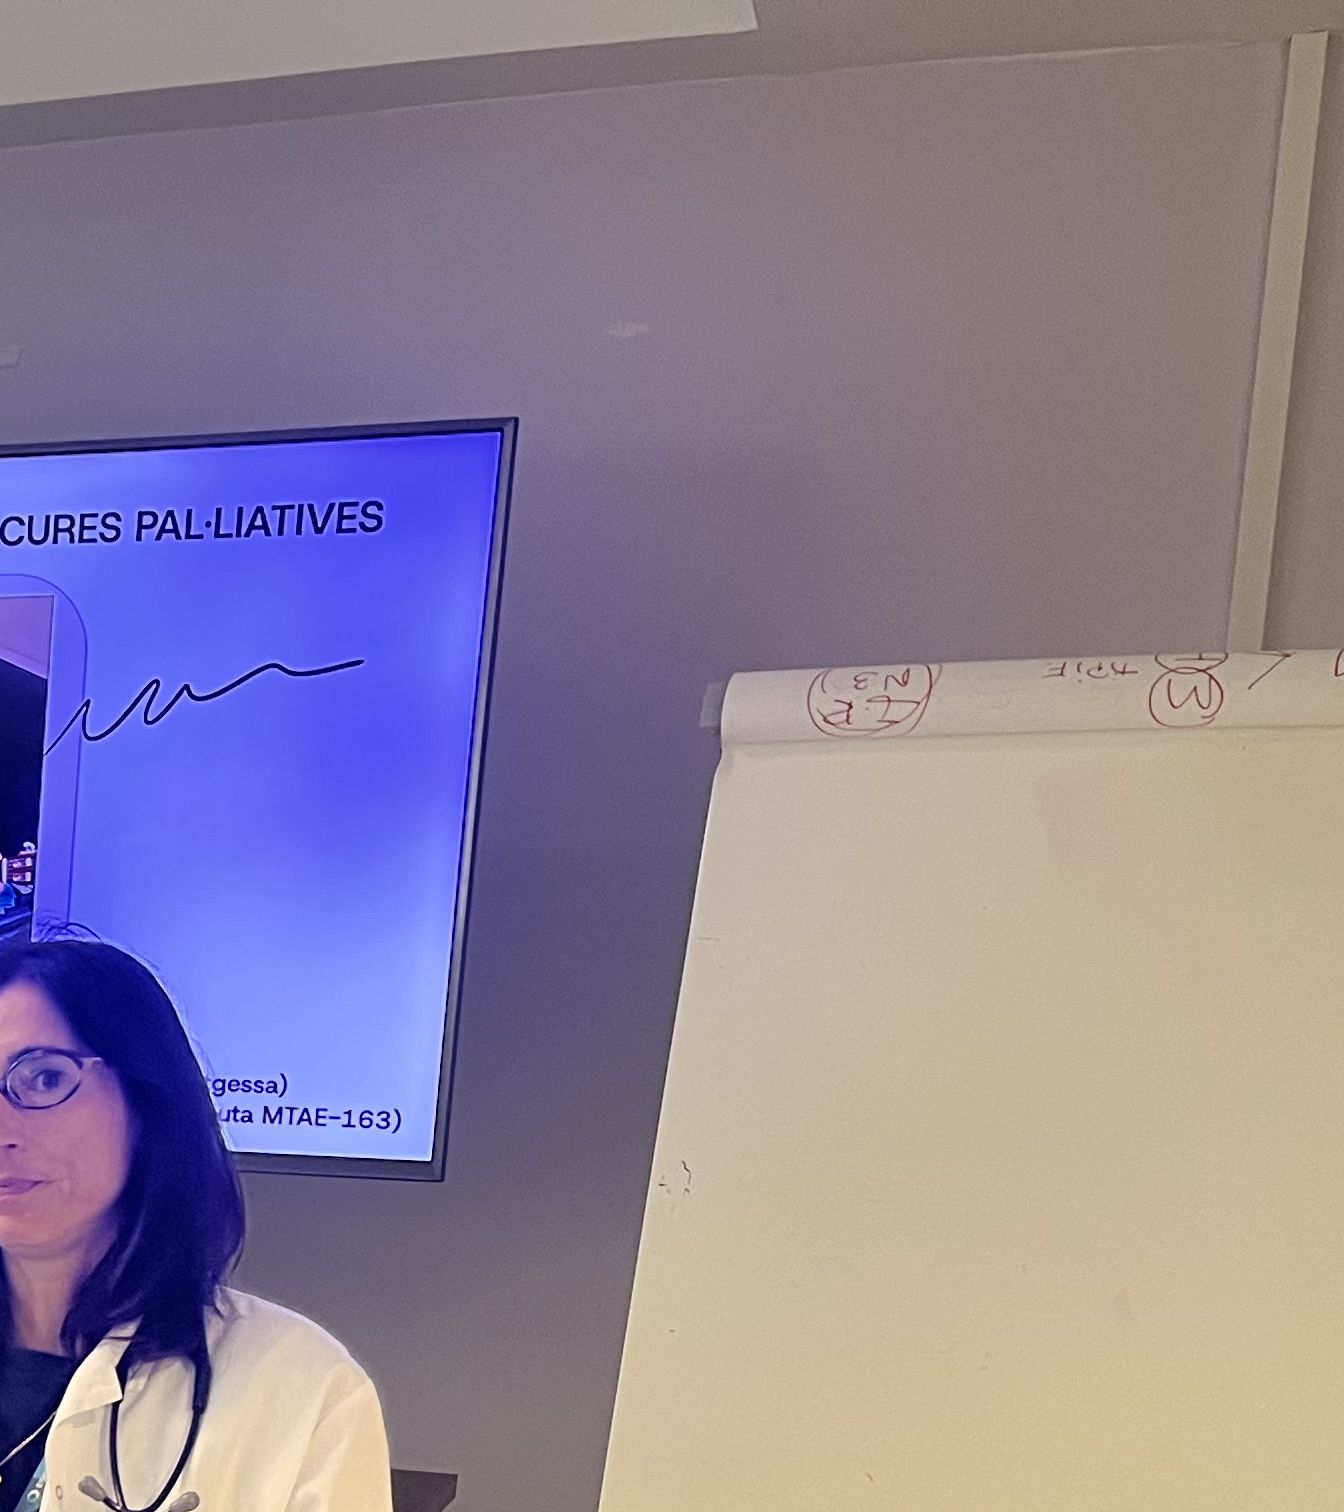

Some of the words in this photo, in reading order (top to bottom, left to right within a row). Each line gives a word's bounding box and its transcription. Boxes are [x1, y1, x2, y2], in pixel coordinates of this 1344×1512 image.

[0, 512, 122, 547] CURES
[135, 500, 385, 542] PAL·LIATIVES
[208, 1072, 288, 1098] gessa)
